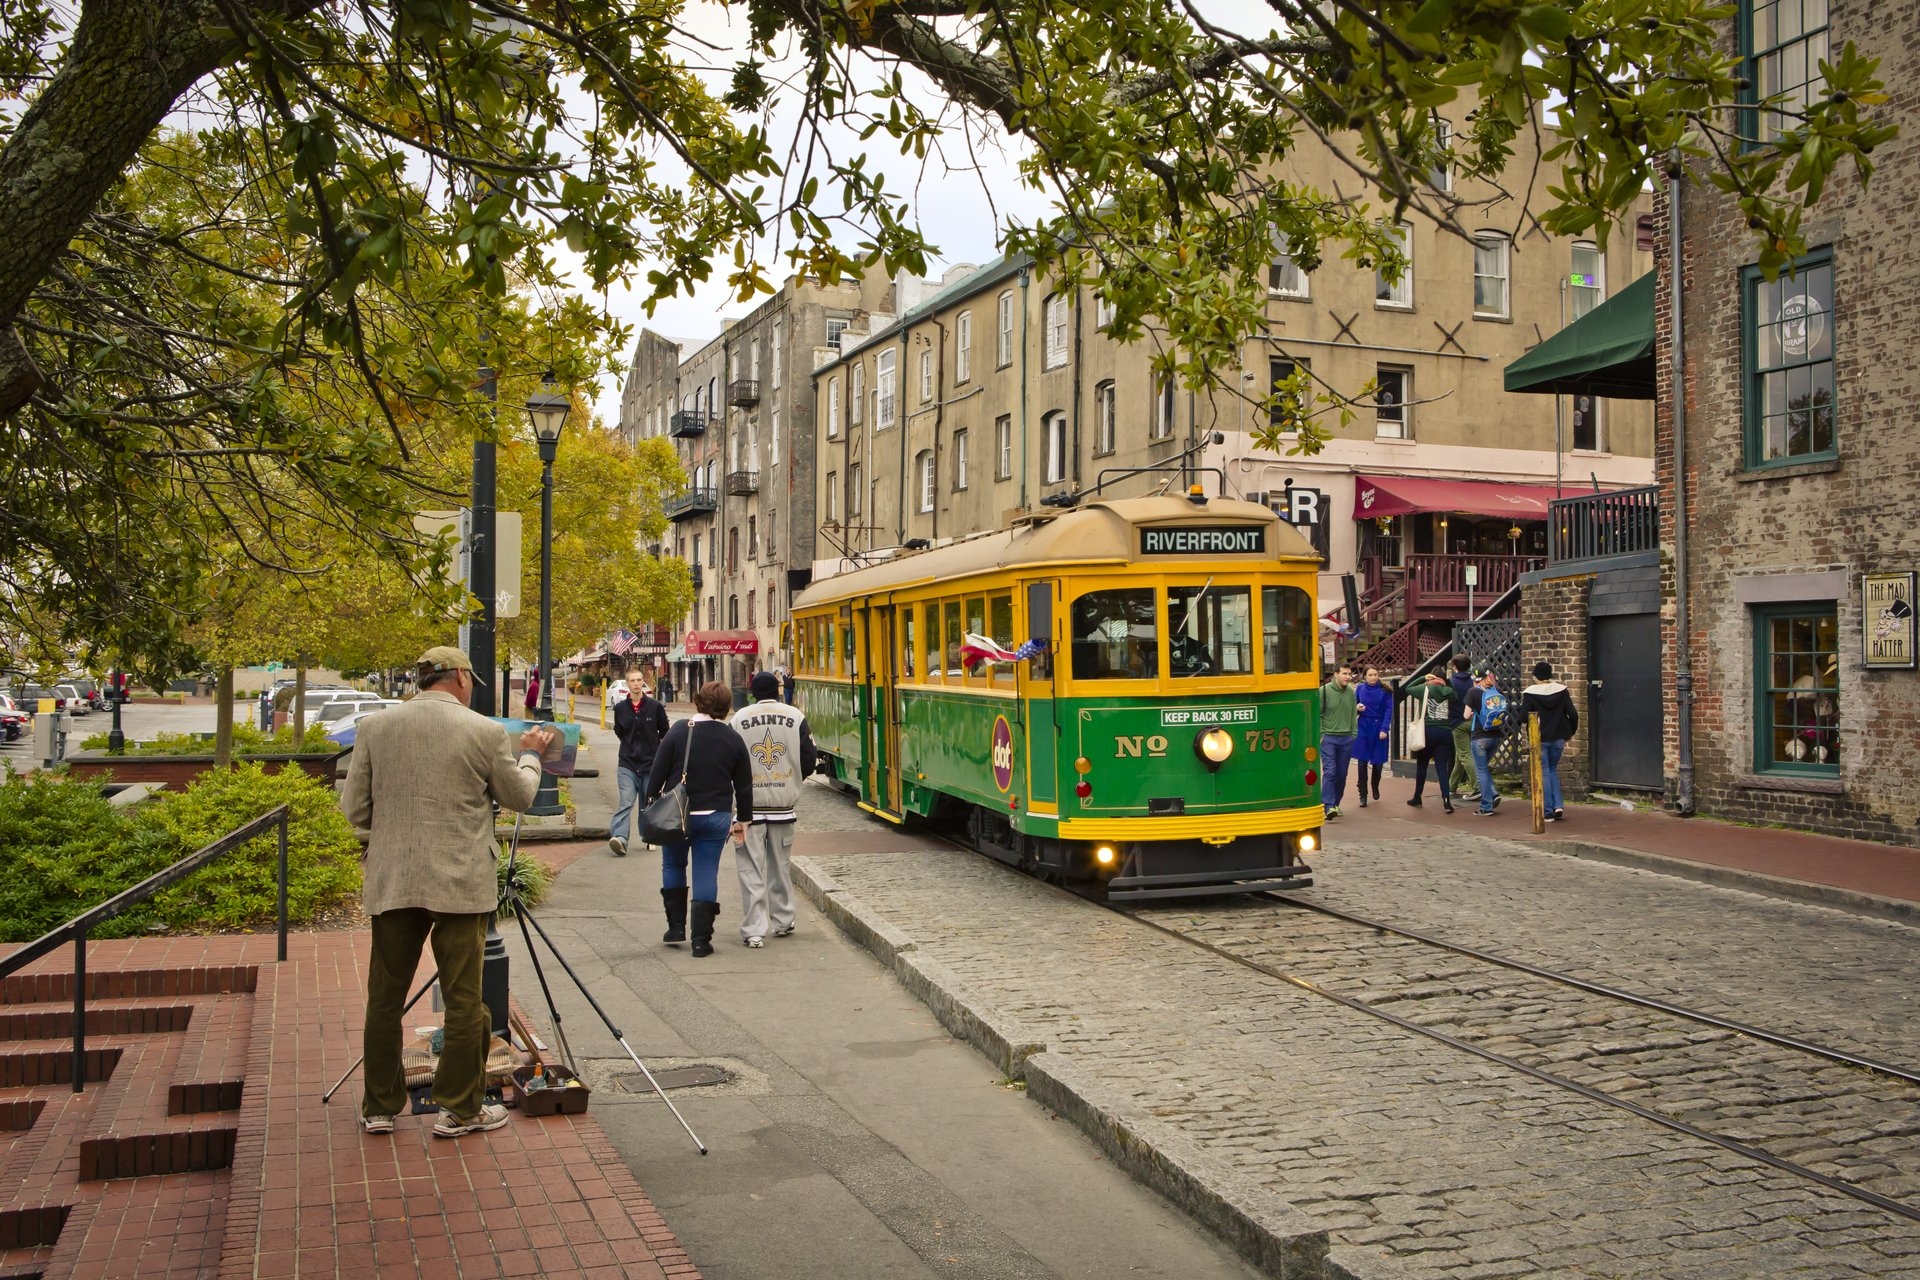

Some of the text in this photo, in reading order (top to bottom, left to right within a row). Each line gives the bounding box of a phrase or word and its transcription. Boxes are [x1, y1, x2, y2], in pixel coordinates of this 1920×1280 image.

[1785, 306, 1802, 315] OLD
[1784, 336, 1806, 347] BRAND
[1291, 490, 1319, 524] R
[1146, 531, 1260, 551] RIVERFRONT
[1869, 582, 1905, 601] THE MAD
[703, 640, 732, 650] Fabulous
[734, 640, 754, 650] Finds
[1872, 639, 1904, 658] HATTER
[740, 714, 795, 730] SAINTS
[1164, 709, 1255, 723] KEEP BACK 30 FEET
[1245, 728, 1291, 752] 756
[994, 738, 1011, 770] dot
